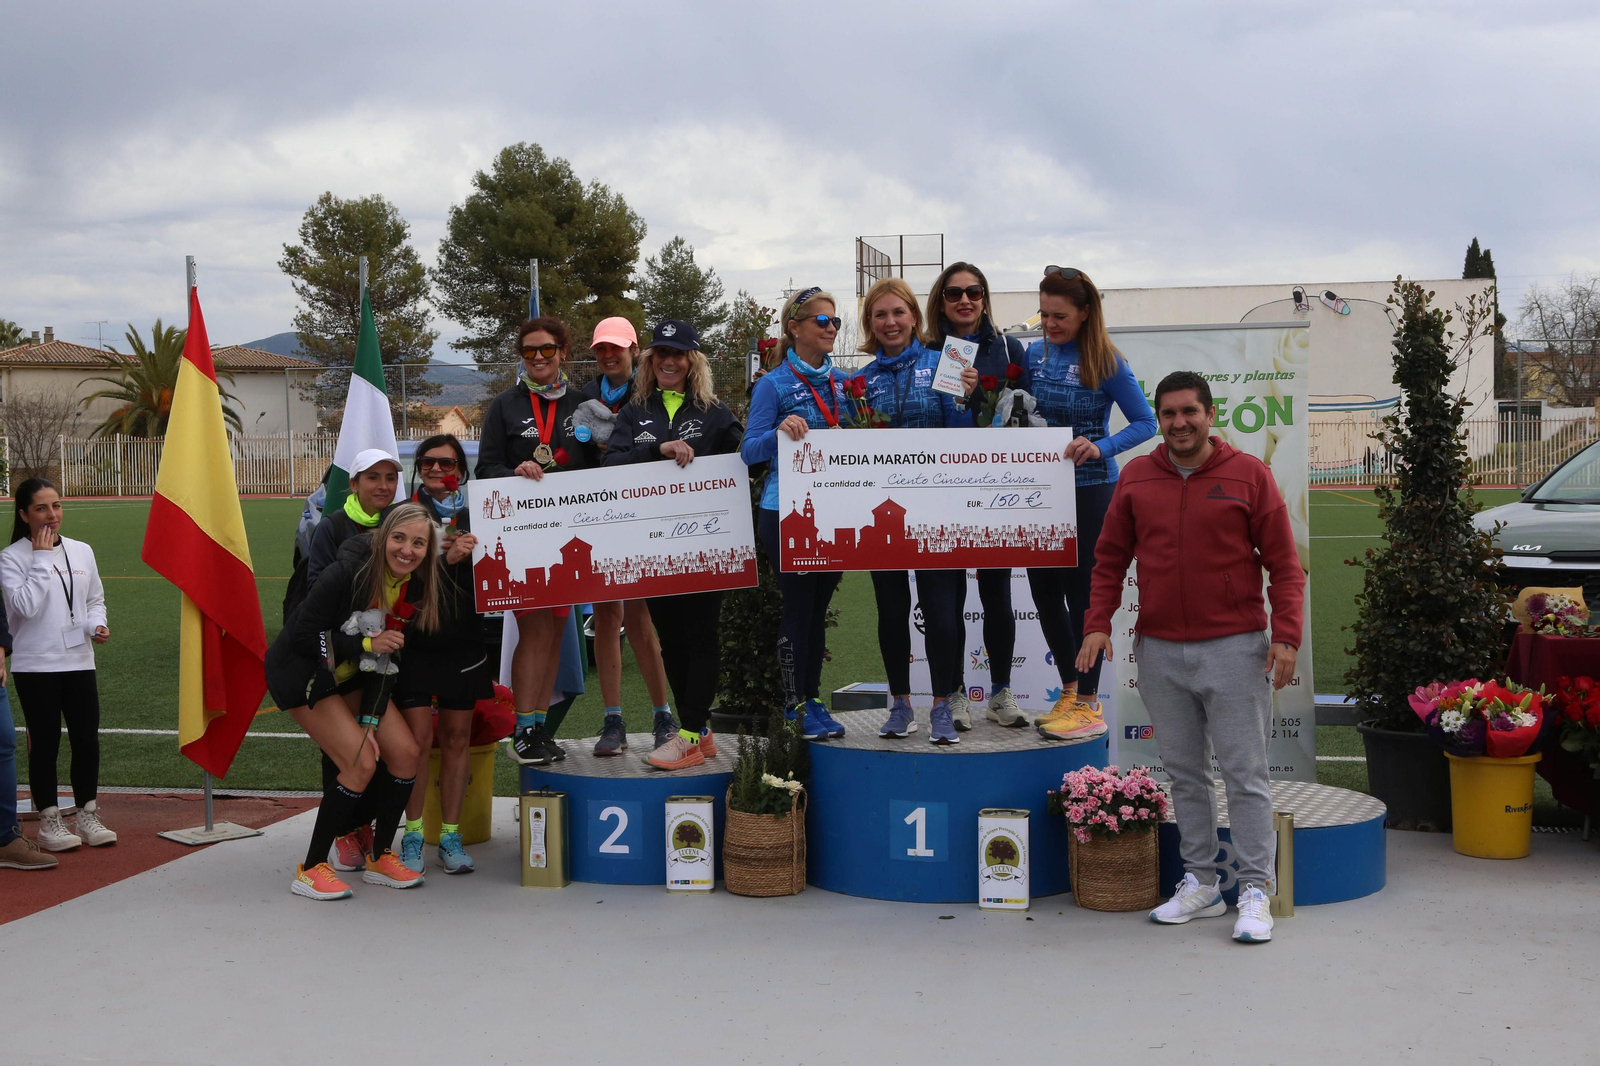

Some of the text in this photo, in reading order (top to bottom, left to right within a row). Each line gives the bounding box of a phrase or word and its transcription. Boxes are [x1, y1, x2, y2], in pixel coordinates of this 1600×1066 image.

[1231, 373, 1242, 384] y
[1243, 370, 1295, 384] plantas
[829, 451, 1060, 466] MEDIA MARATÓN CIUDAD DE LUCENA
[824, 480, 860, 488] cantidad
[888, 472, 1036, 486] Ciento Cincuenta Euros
[517, 478, 736, 511] MEDIA MARATÓN CIUDAD DE LUCENA
[990, 490, 1043, 508] 150 €
[967, 500, 983, 508] EUR:
[572, 509, 637, 524] Cien Euros
[503, 521, 562, 532] La cantidad de:
[672, 521, 698, 537] 100
[703, 516, 721, 534] €
[649, 531, 665, 540] EUR:
[1280, 718, 1301, 726] 505
[1282, 730, 1299, 738] 114
[599, 806, 630, 854] 2
[904, 807, 934, 856] 1
